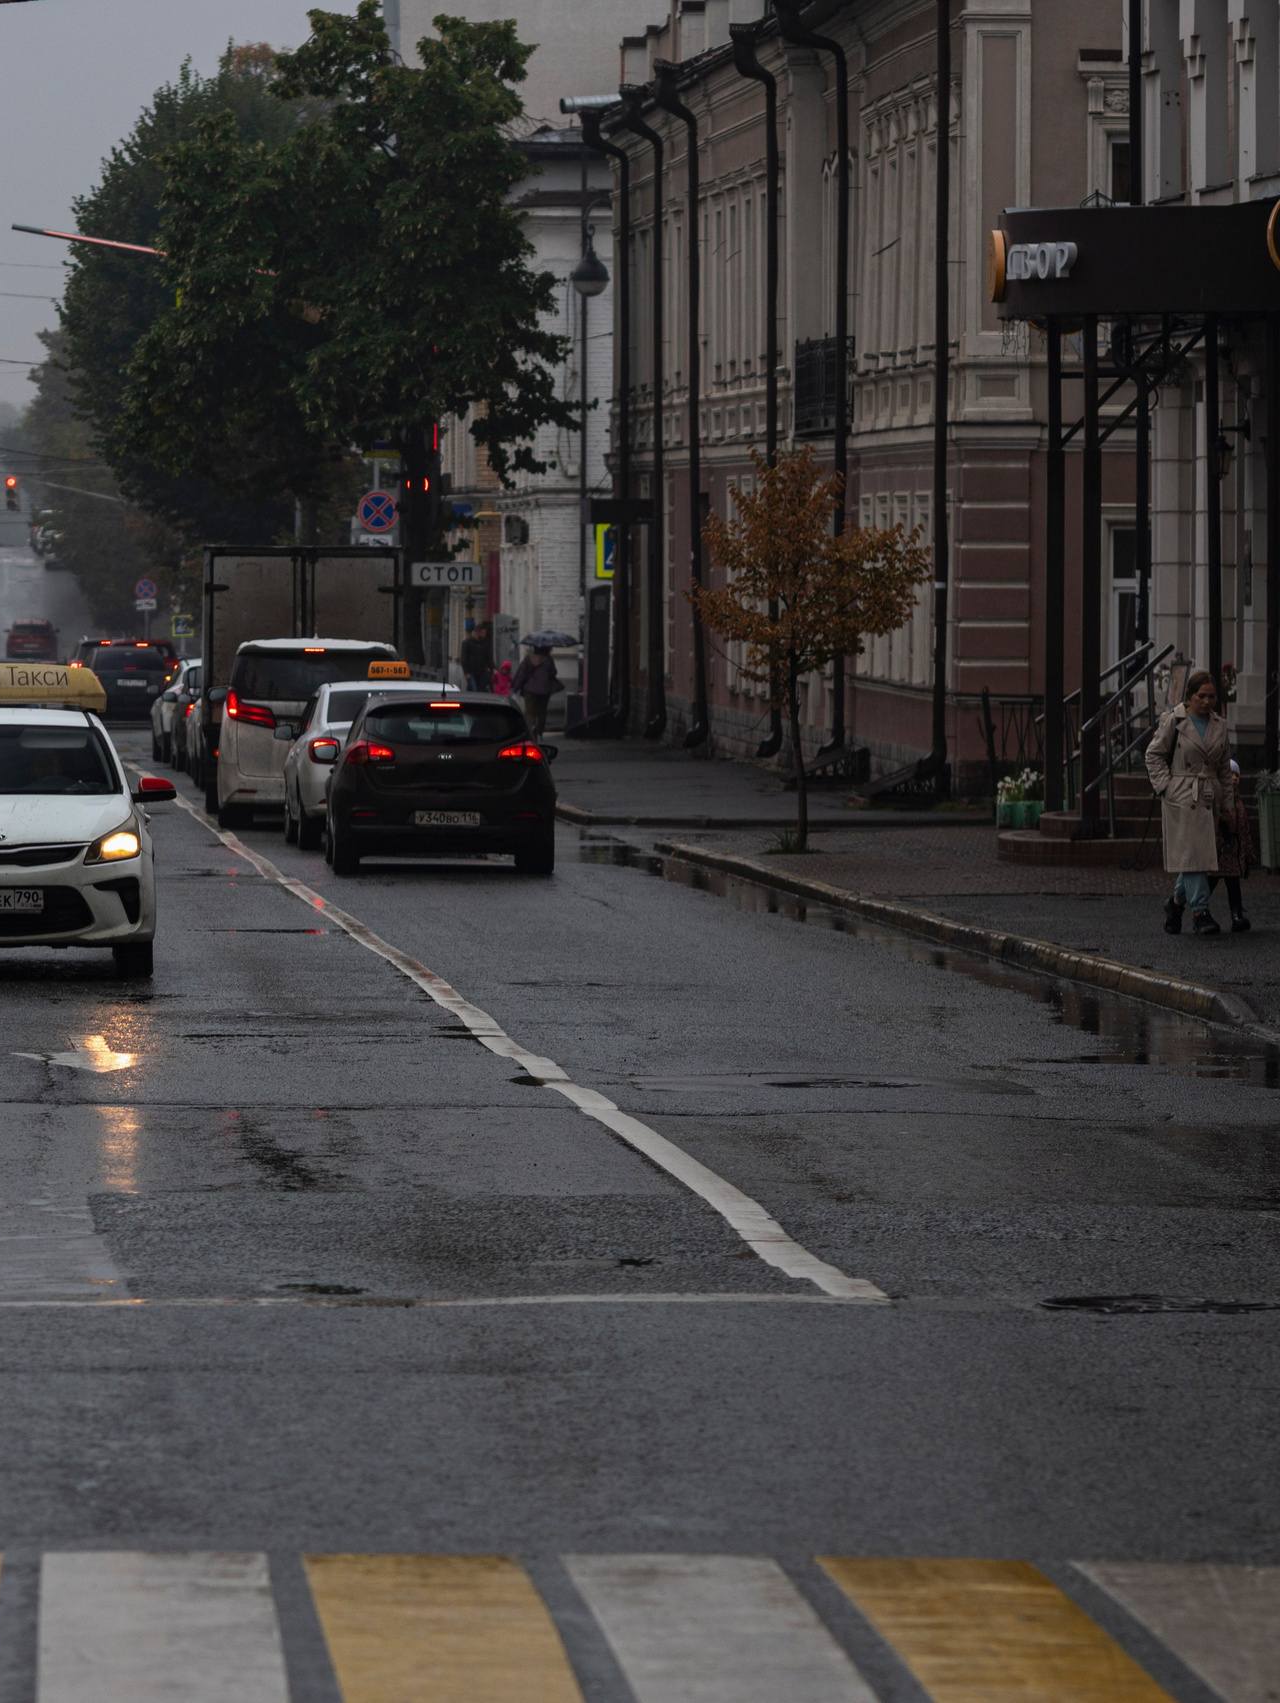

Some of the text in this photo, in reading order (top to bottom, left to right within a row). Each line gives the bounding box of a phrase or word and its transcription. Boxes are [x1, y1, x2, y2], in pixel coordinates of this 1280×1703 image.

[1006, 241, 1077, 280] ДВОР
[420, 566, 472, 582] СТОП
[5, 666, 69, 687] Такси
[16, 891, 39, 903] 790
